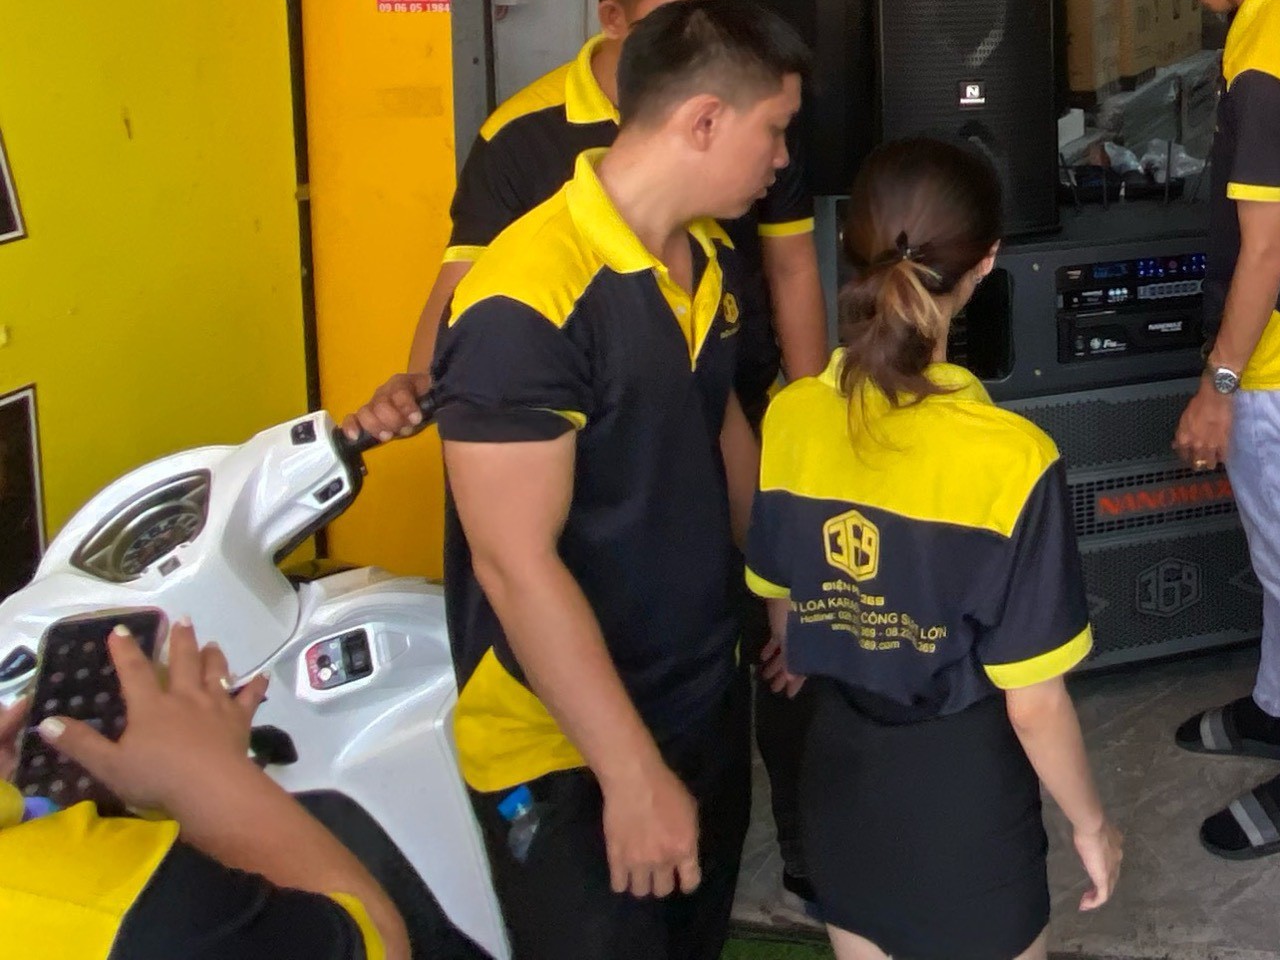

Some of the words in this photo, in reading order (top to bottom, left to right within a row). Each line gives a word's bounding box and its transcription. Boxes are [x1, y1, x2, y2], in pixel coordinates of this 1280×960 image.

[379, 3, 392, 13] 09
[394, 3, 407, 13] 06
[409, 3, 423, 13] 05
[425, 3, 449, 13] 1984
[800, 599, 826, 612] LOA
[861, 611, 898, 625] CÔNG
